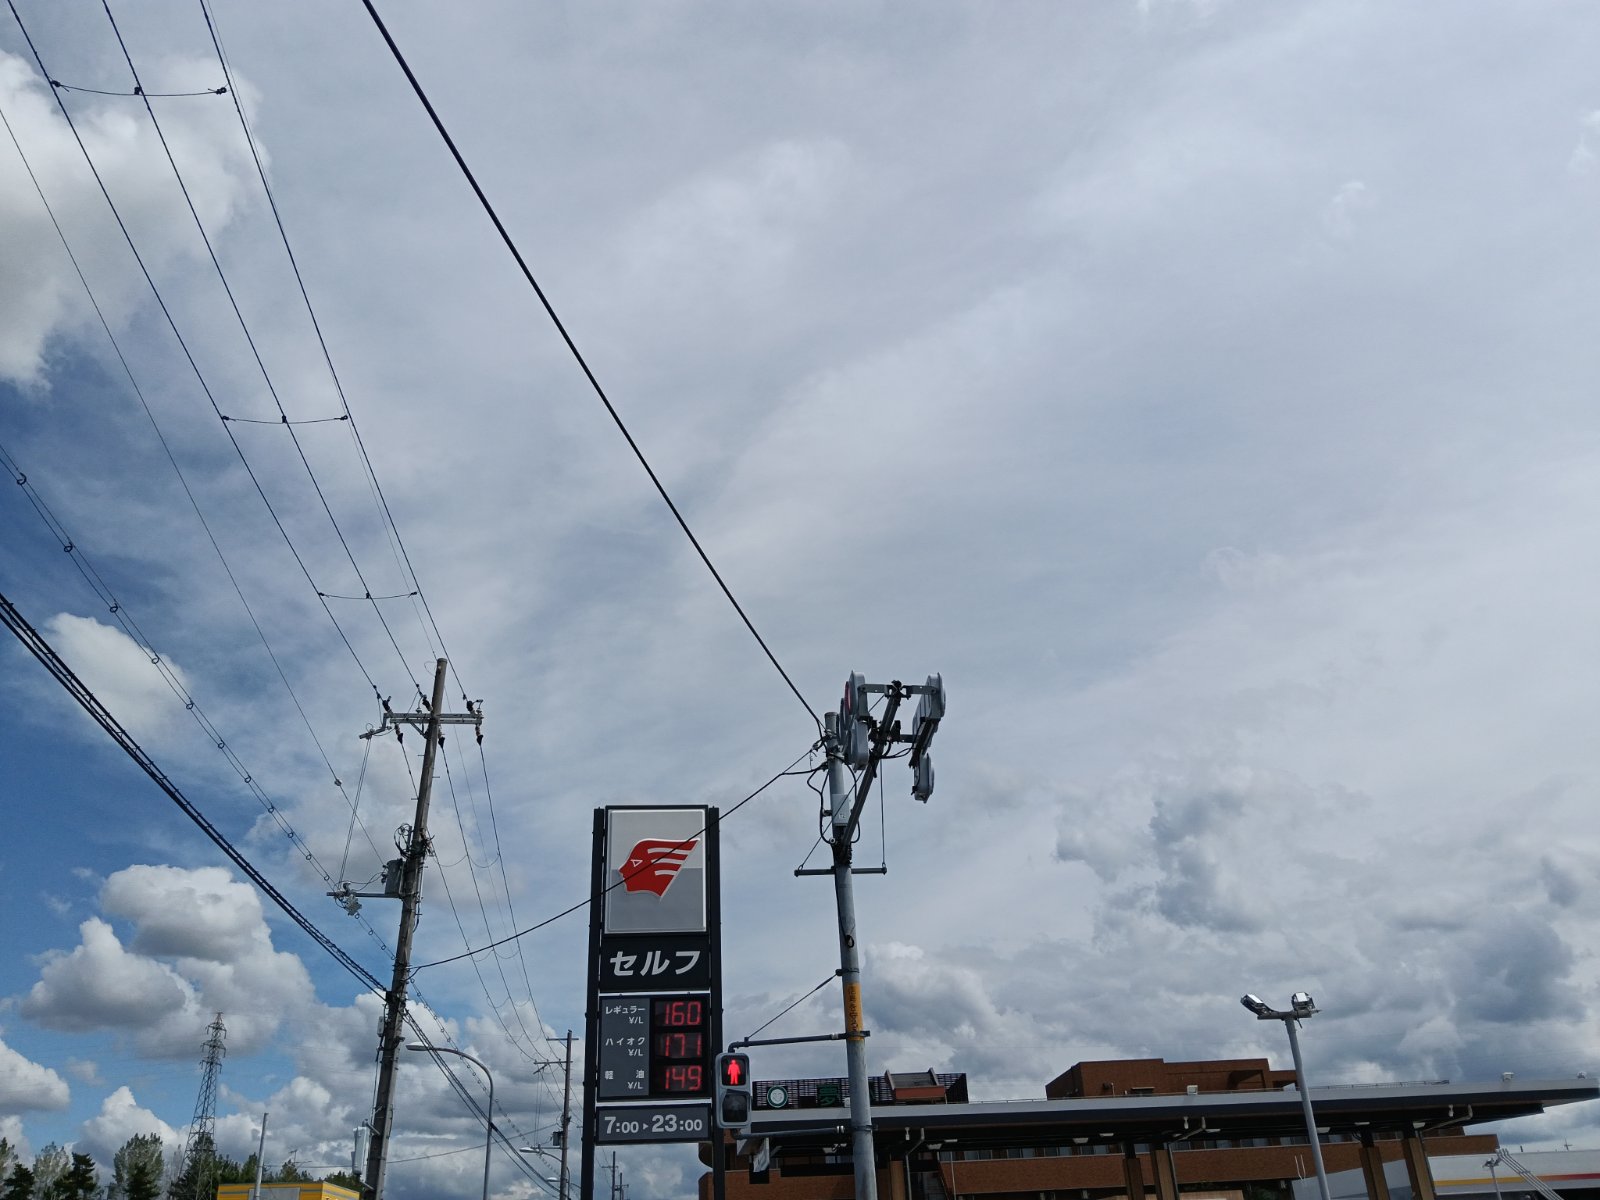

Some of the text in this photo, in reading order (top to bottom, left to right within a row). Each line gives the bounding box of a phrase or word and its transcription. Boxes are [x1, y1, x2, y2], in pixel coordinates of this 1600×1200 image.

[609, 950, 701, 977] セルフ
[605, 1001, 702, 1026] レギュラー 160
[629, 1016, 644, 1025] ¥/L
[605, 1033, 702, 1057] ハイオク 171
[627, 1048, 644, 1057] ¥/L
[627, 1081, 643, 1090] ¥/L
[664, 1065, 702, 1091] 149
[604, 1114, 703, 1134] 7:00 23:00
